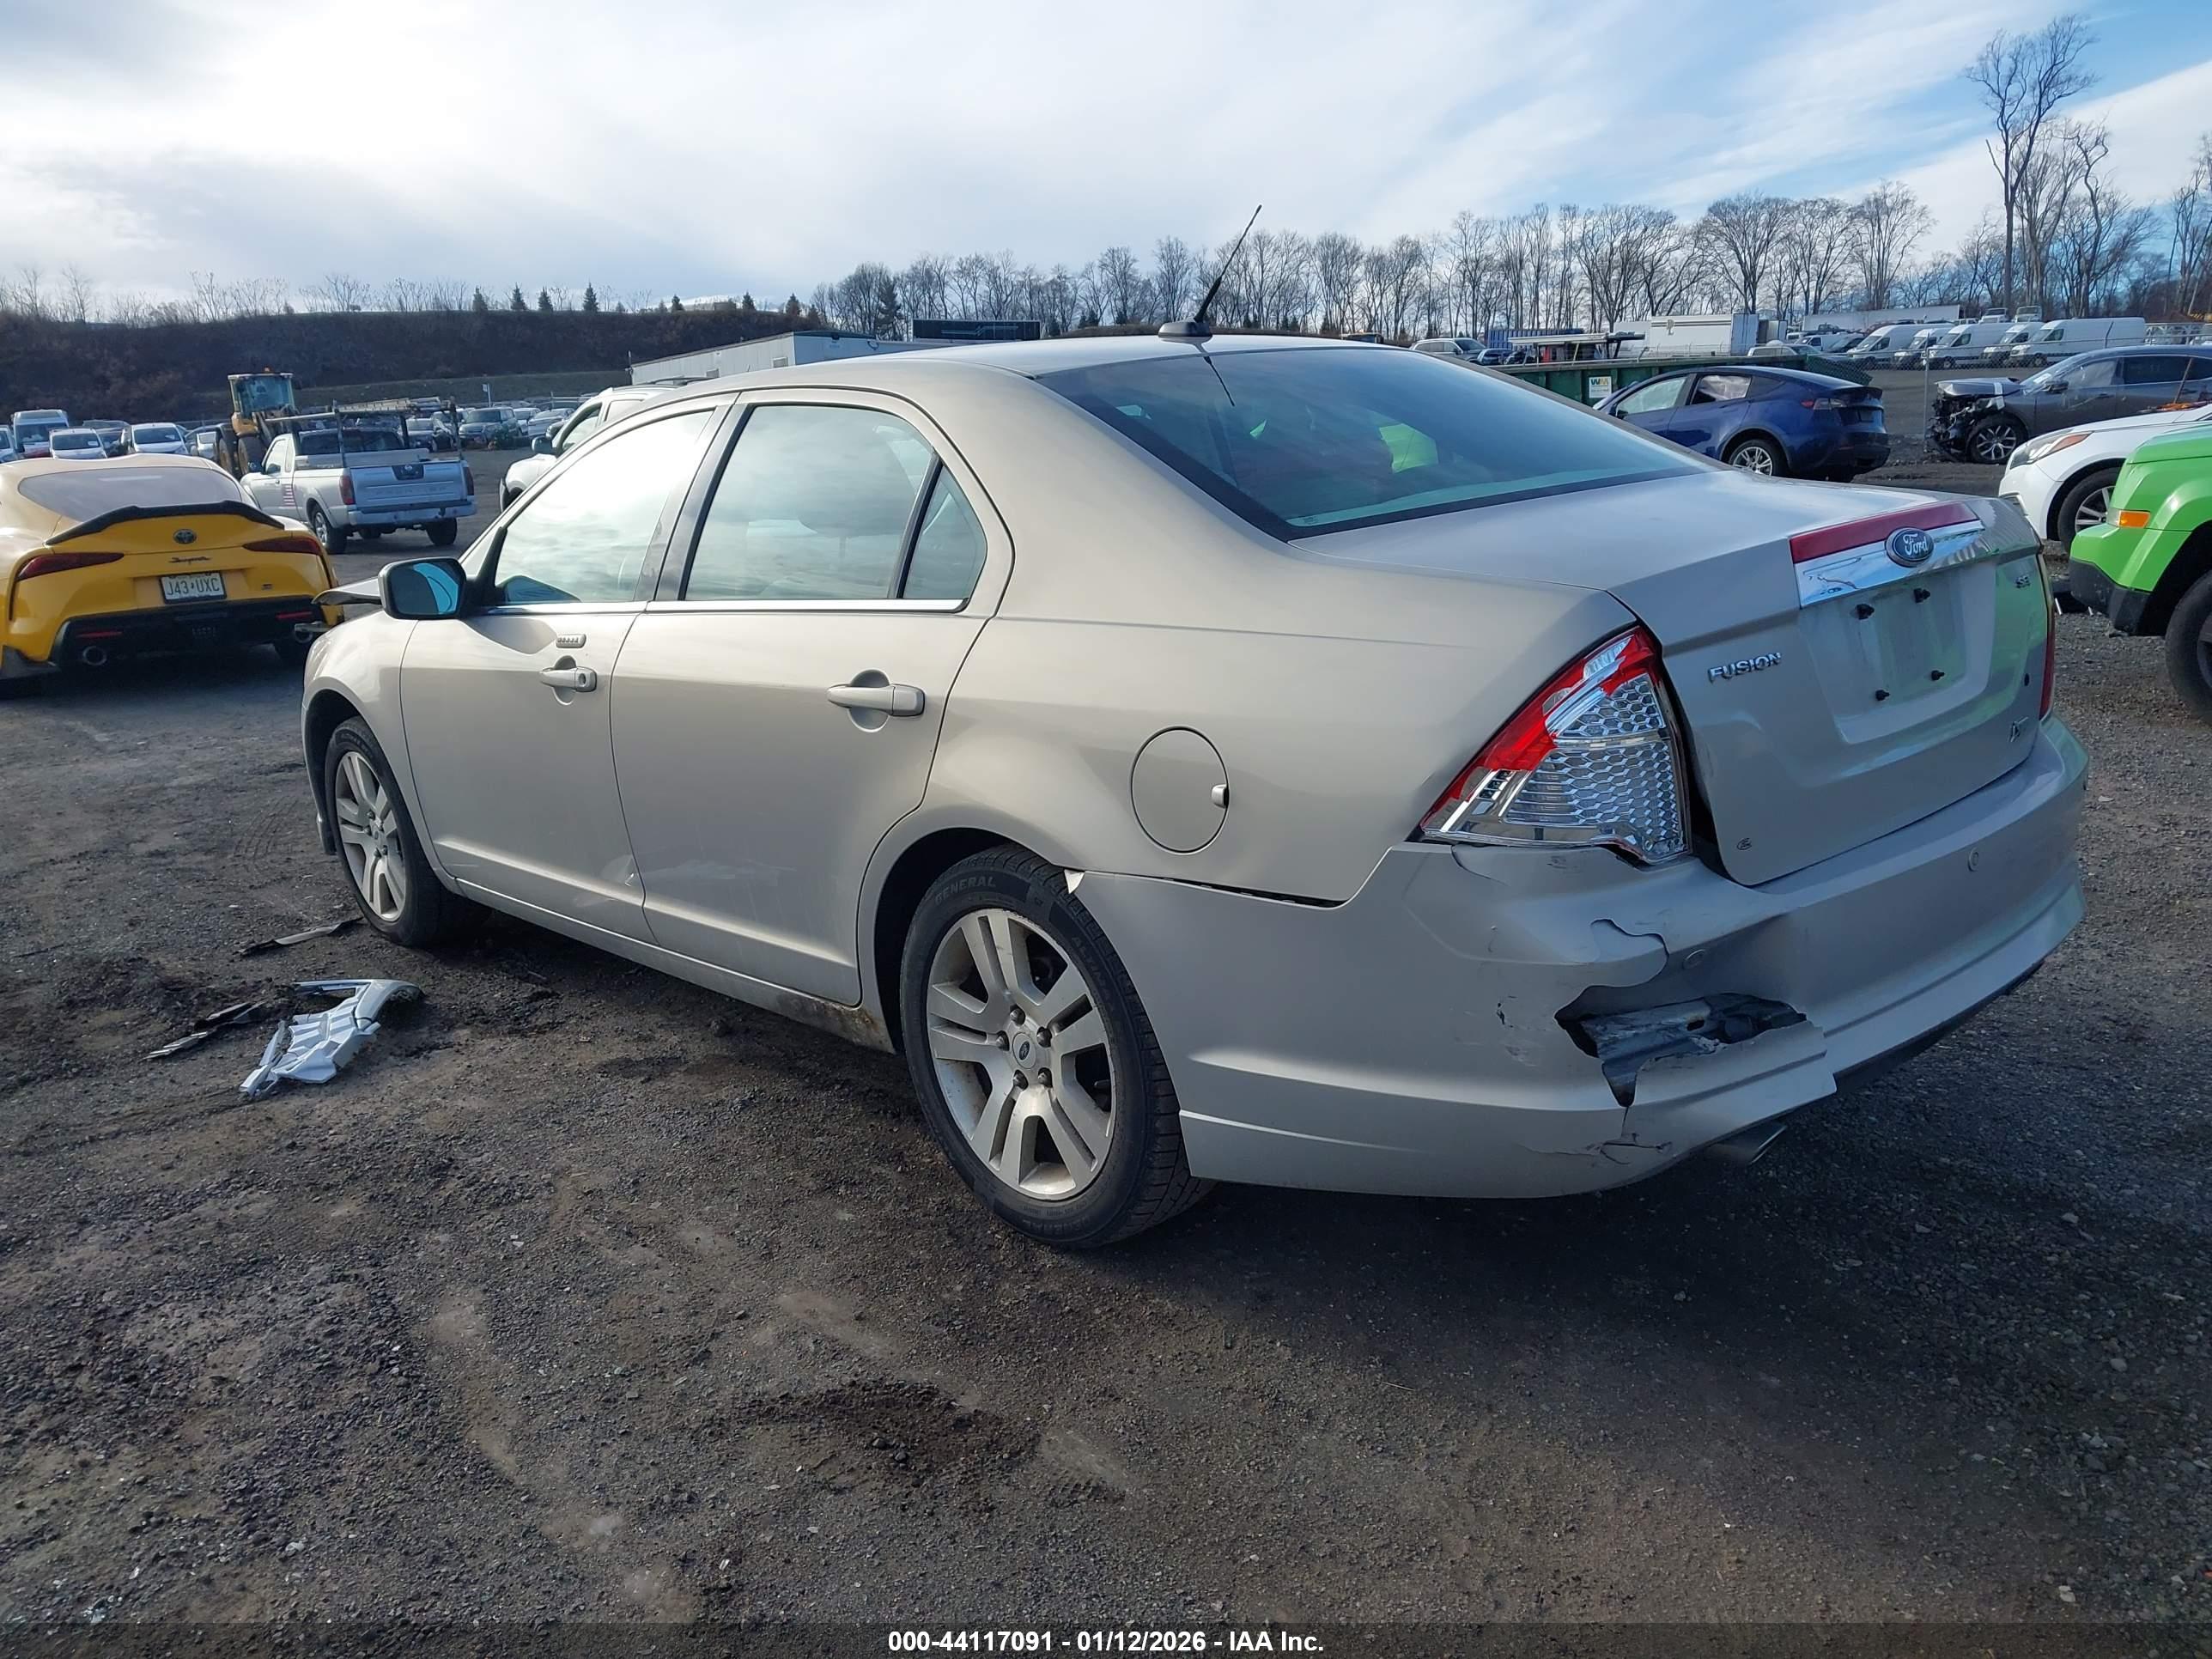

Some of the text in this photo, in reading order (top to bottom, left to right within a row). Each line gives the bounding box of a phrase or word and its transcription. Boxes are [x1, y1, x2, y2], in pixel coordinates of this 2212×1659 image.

[1902, 532, 1929, 556] Ford
[1708, 652, 1782, 684] FUSION
[935, 876, 997, 907] GENERAL
